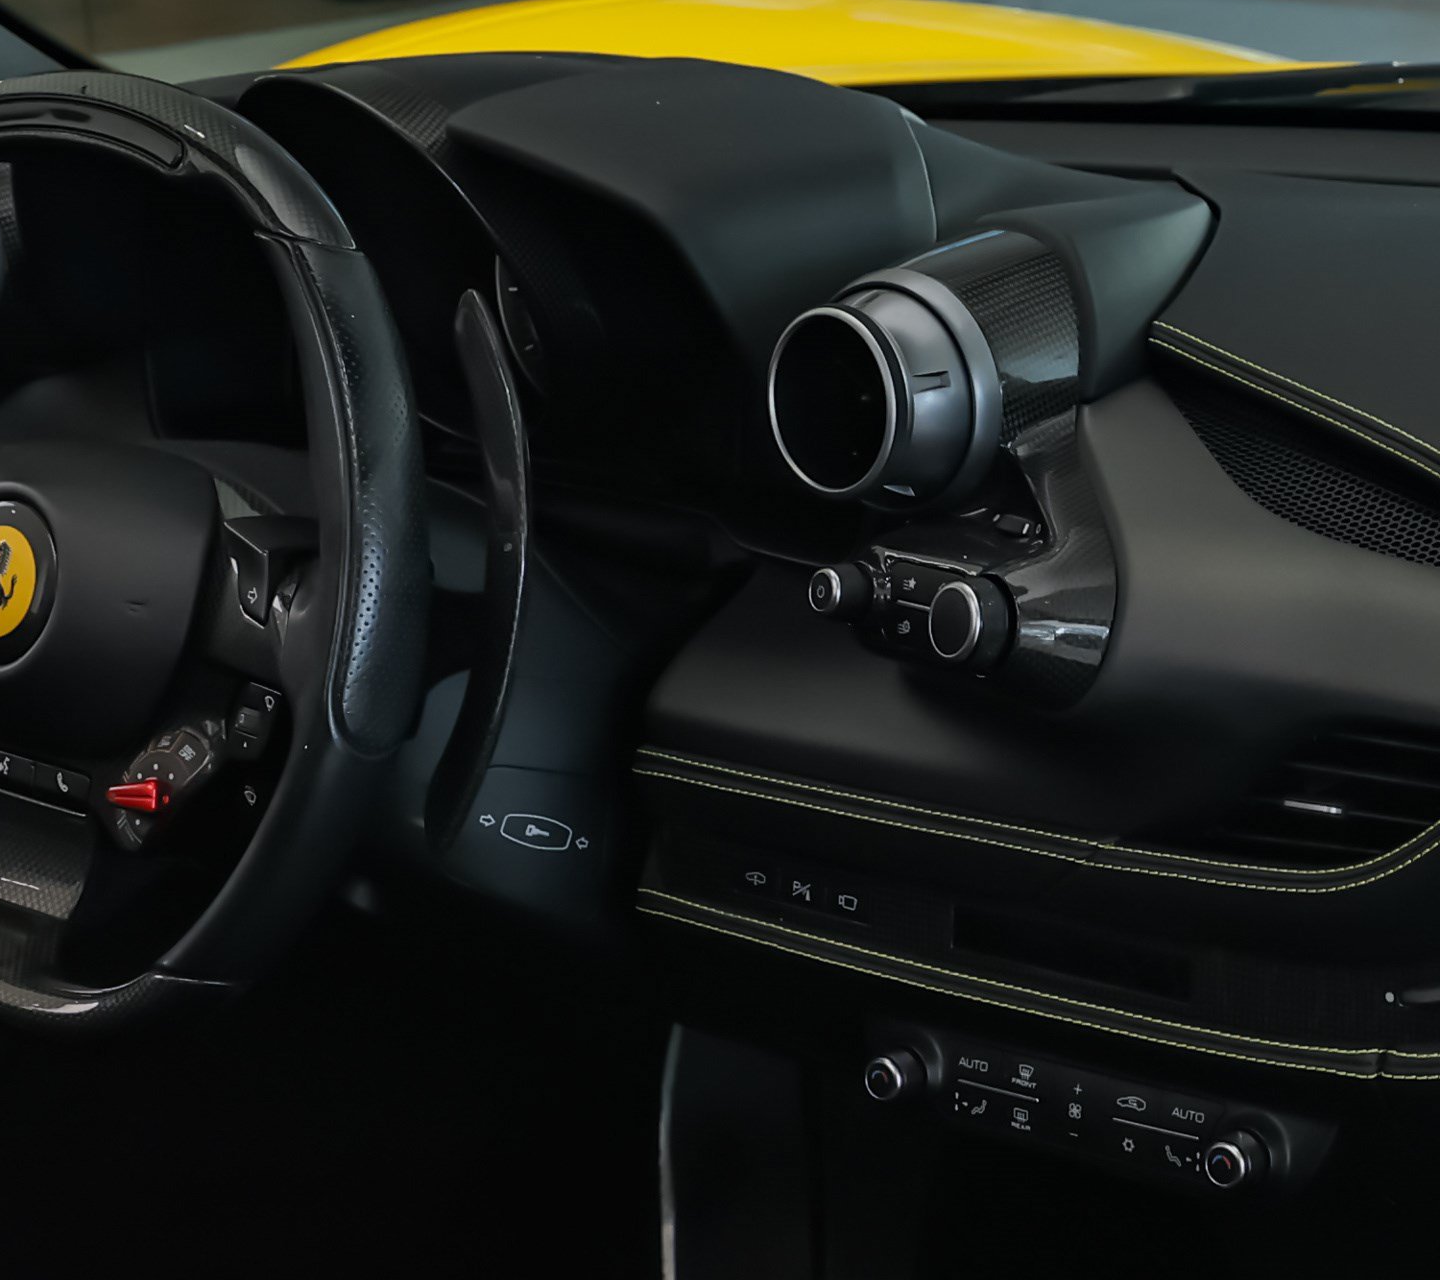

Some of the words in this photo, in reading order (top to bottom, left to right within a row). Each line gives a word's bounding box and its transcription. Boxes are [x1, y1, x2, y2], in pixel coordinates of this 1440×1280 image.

[958, 1056, 989, 1072] AUTO
[1011, 1077, 1037, 1089] FRONT
[1171, 1106, 1205, 1123] AUTO
[1010, 1121, 1031, 1131] REAR
